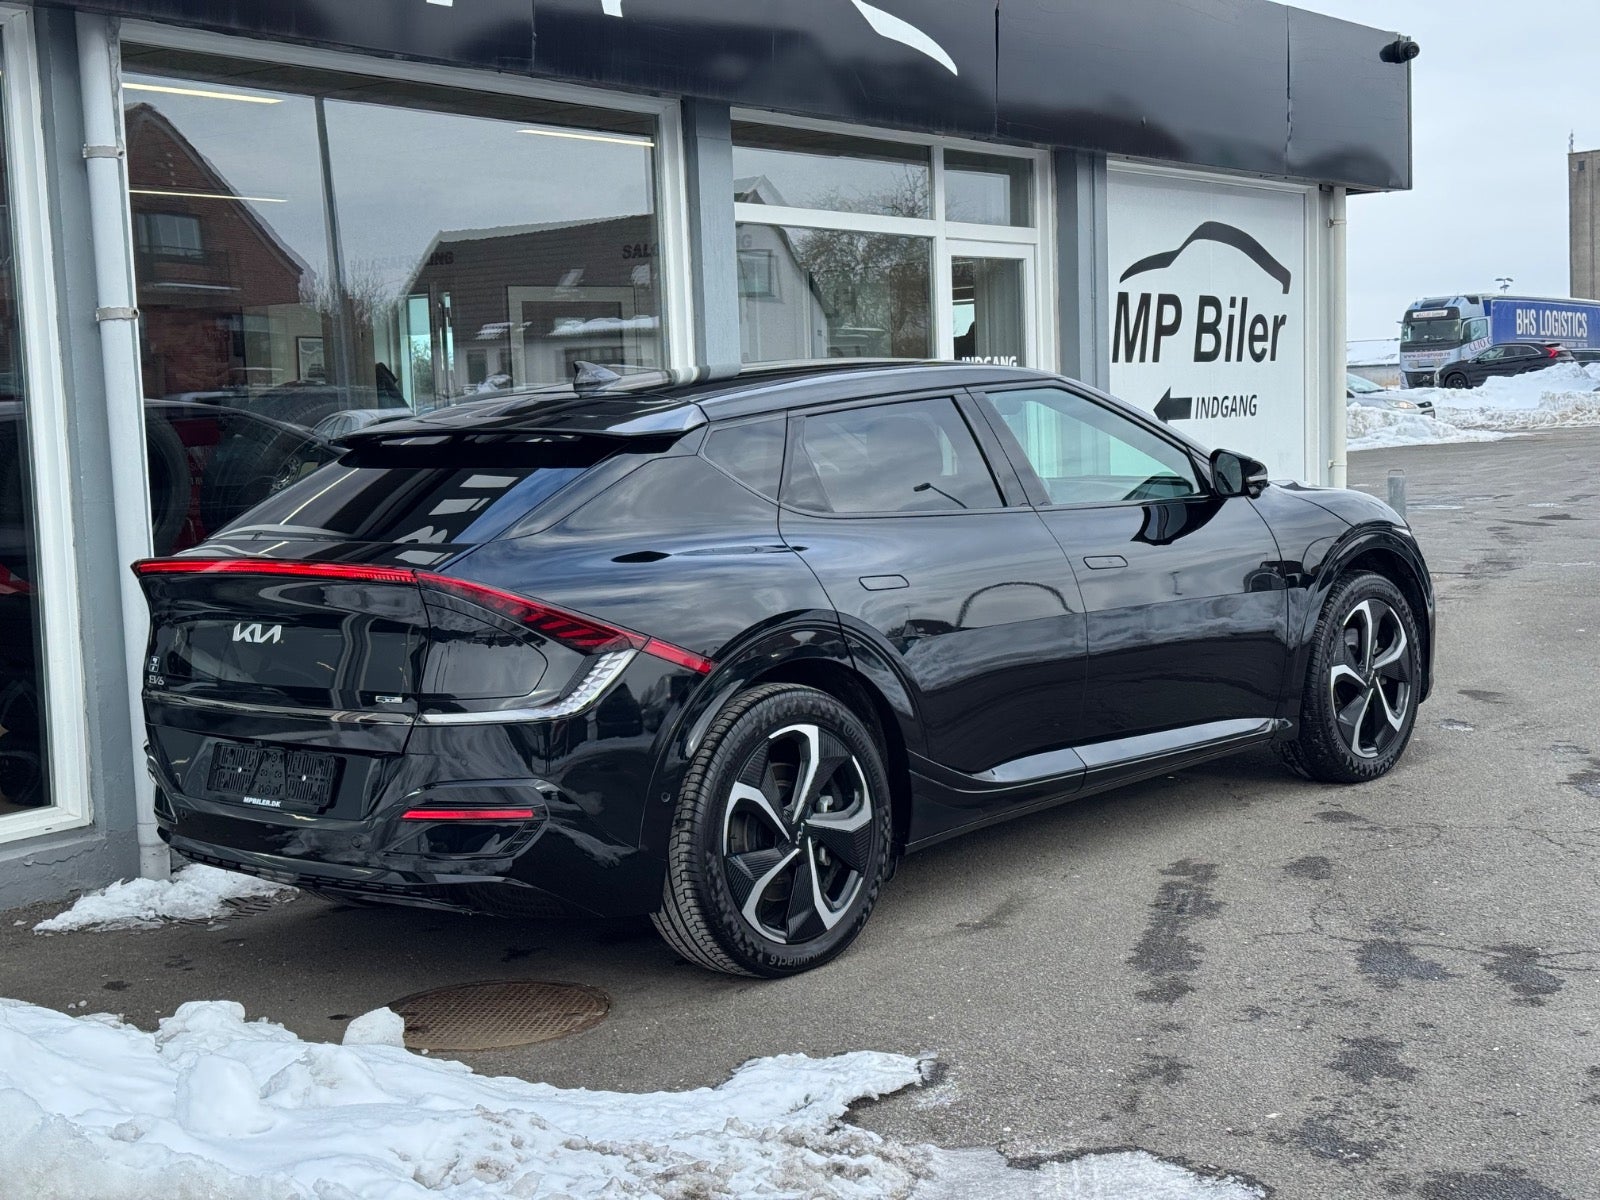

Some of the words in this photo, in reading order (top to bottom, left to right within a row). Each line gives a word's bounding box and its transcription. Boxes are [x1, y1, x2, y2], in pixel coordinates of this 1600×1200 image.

[1112, 292, 1182, 363] MP
[1193, 295, 1287, 363] Biler
[1516, 308, 1537, 335] BHS
[1539, 309, 1588, 338] LOGISTICS
[1195, 395, 1257, 419] INDGANG
[232, 622, 282, 644] KIA
[243, 796, 281, 807] MPBILER.DK
